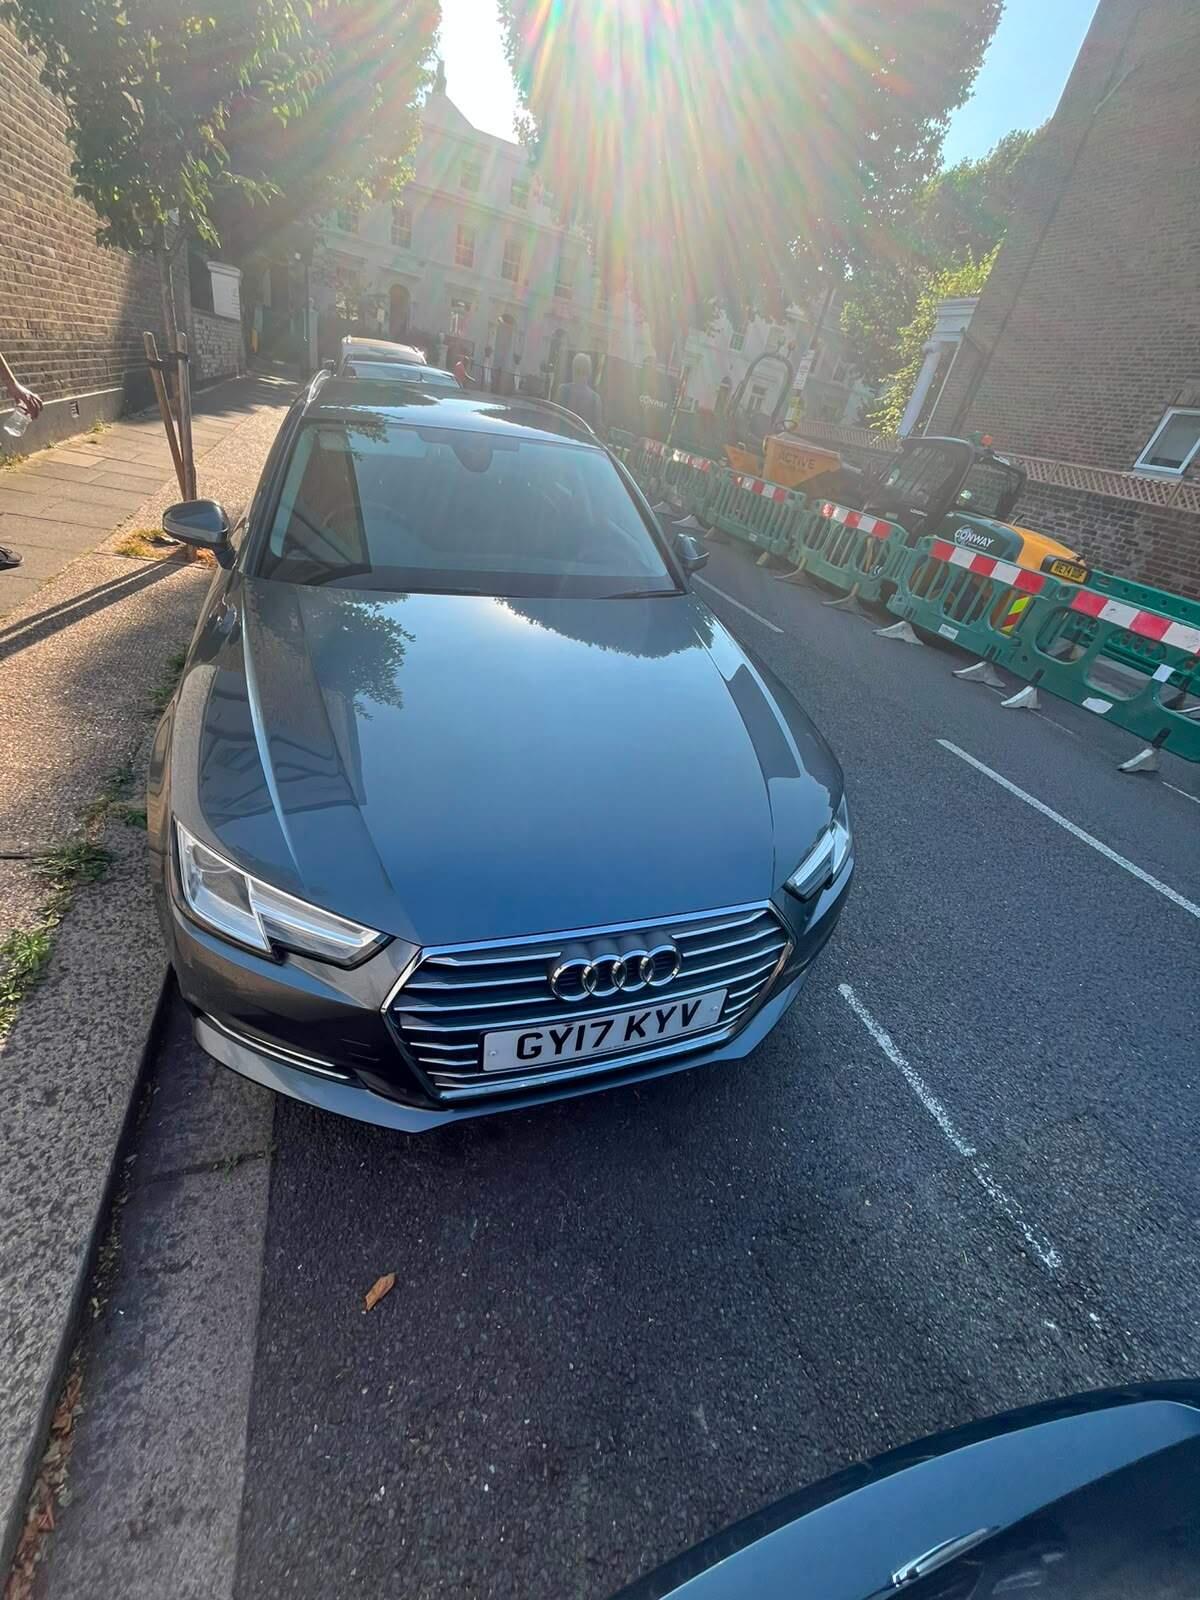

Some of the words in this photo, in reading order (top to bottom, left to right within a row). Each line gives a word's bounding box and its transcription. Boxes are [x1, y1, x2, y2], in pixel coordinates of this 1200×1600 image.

[954, 529, 994, 548] CONWAY
[516, 1020, 615, 1060] GY17
[623, 999, 703, 1041] KYV
